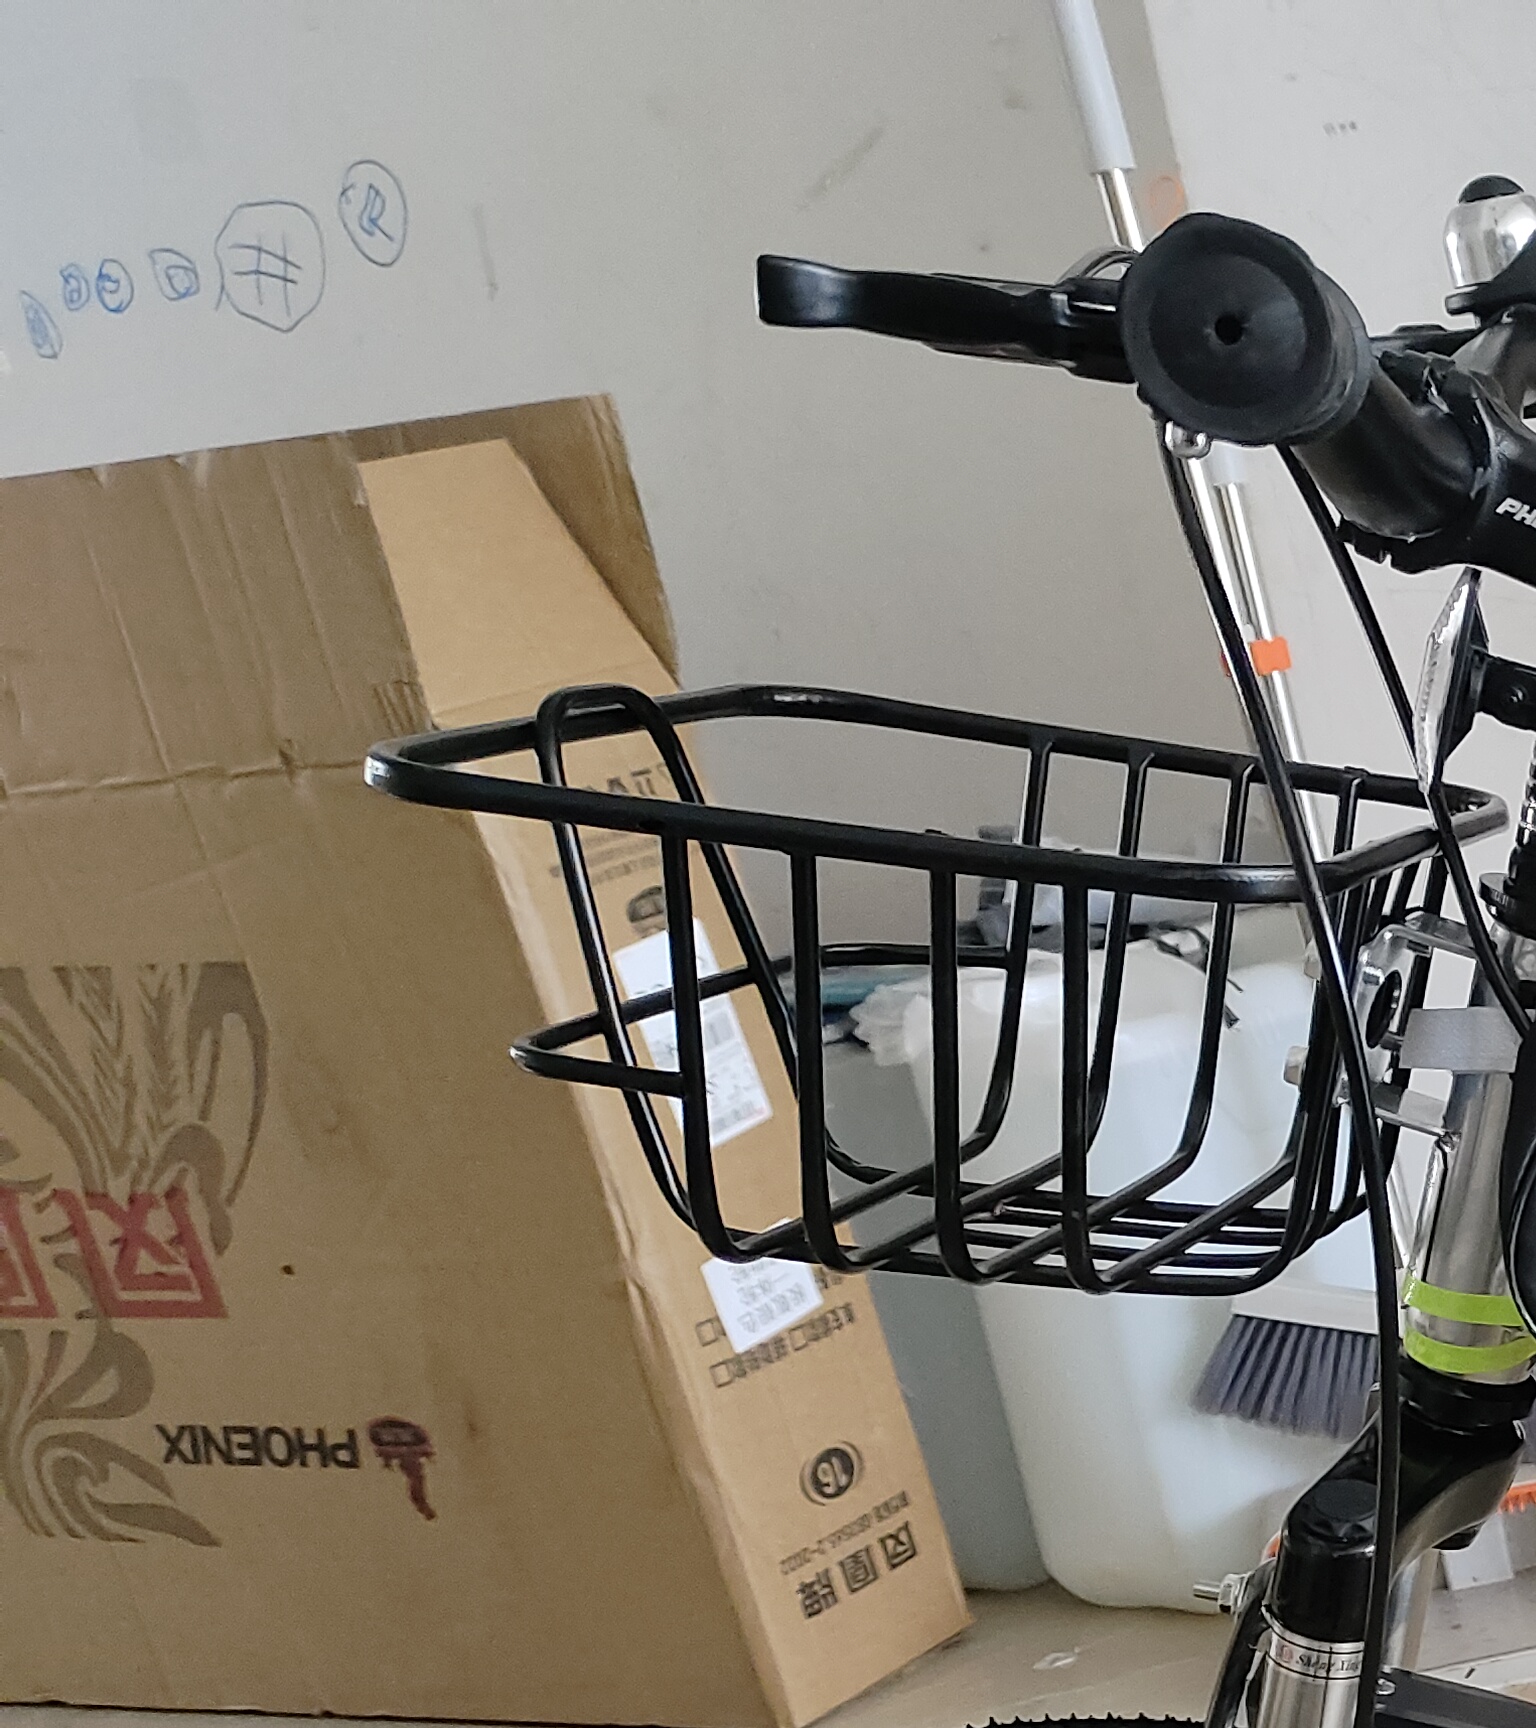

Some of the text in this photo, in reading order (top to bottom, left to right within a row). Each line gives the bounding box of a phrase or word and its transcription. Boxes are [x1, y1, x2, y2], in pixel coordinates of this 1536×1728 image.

[155, 1423, 360, 1469] PHOENIX
[816, 1455, 850, 1495] 16
[797, 1520, 918, 1619] 凤凰牌
